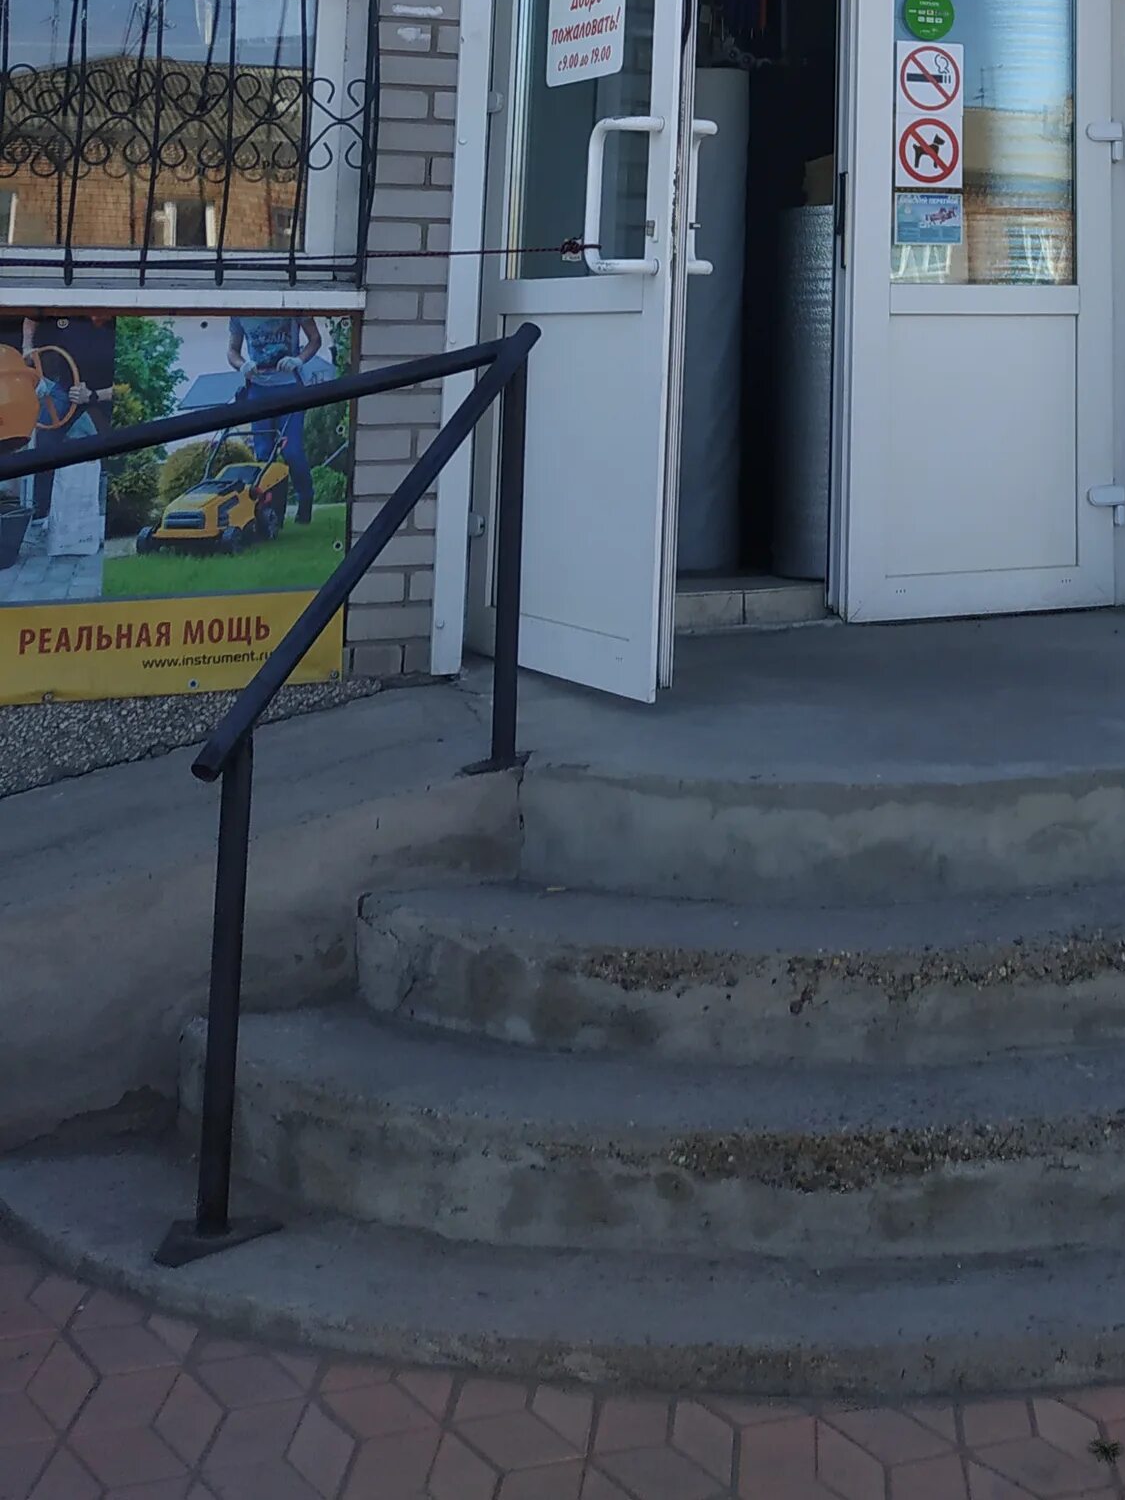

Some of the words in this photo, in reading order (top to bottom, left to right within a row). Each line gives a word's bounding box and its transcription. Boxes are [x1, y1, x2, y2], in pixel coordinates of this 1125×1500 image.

[551, 6, 621, 45] пожаловать!
[591, 45, 612, 64] 19.00
[18, 621, 171, 655] РЕАЛЬНАЯ
[183, 615, 271, 646] МОЩЬ
